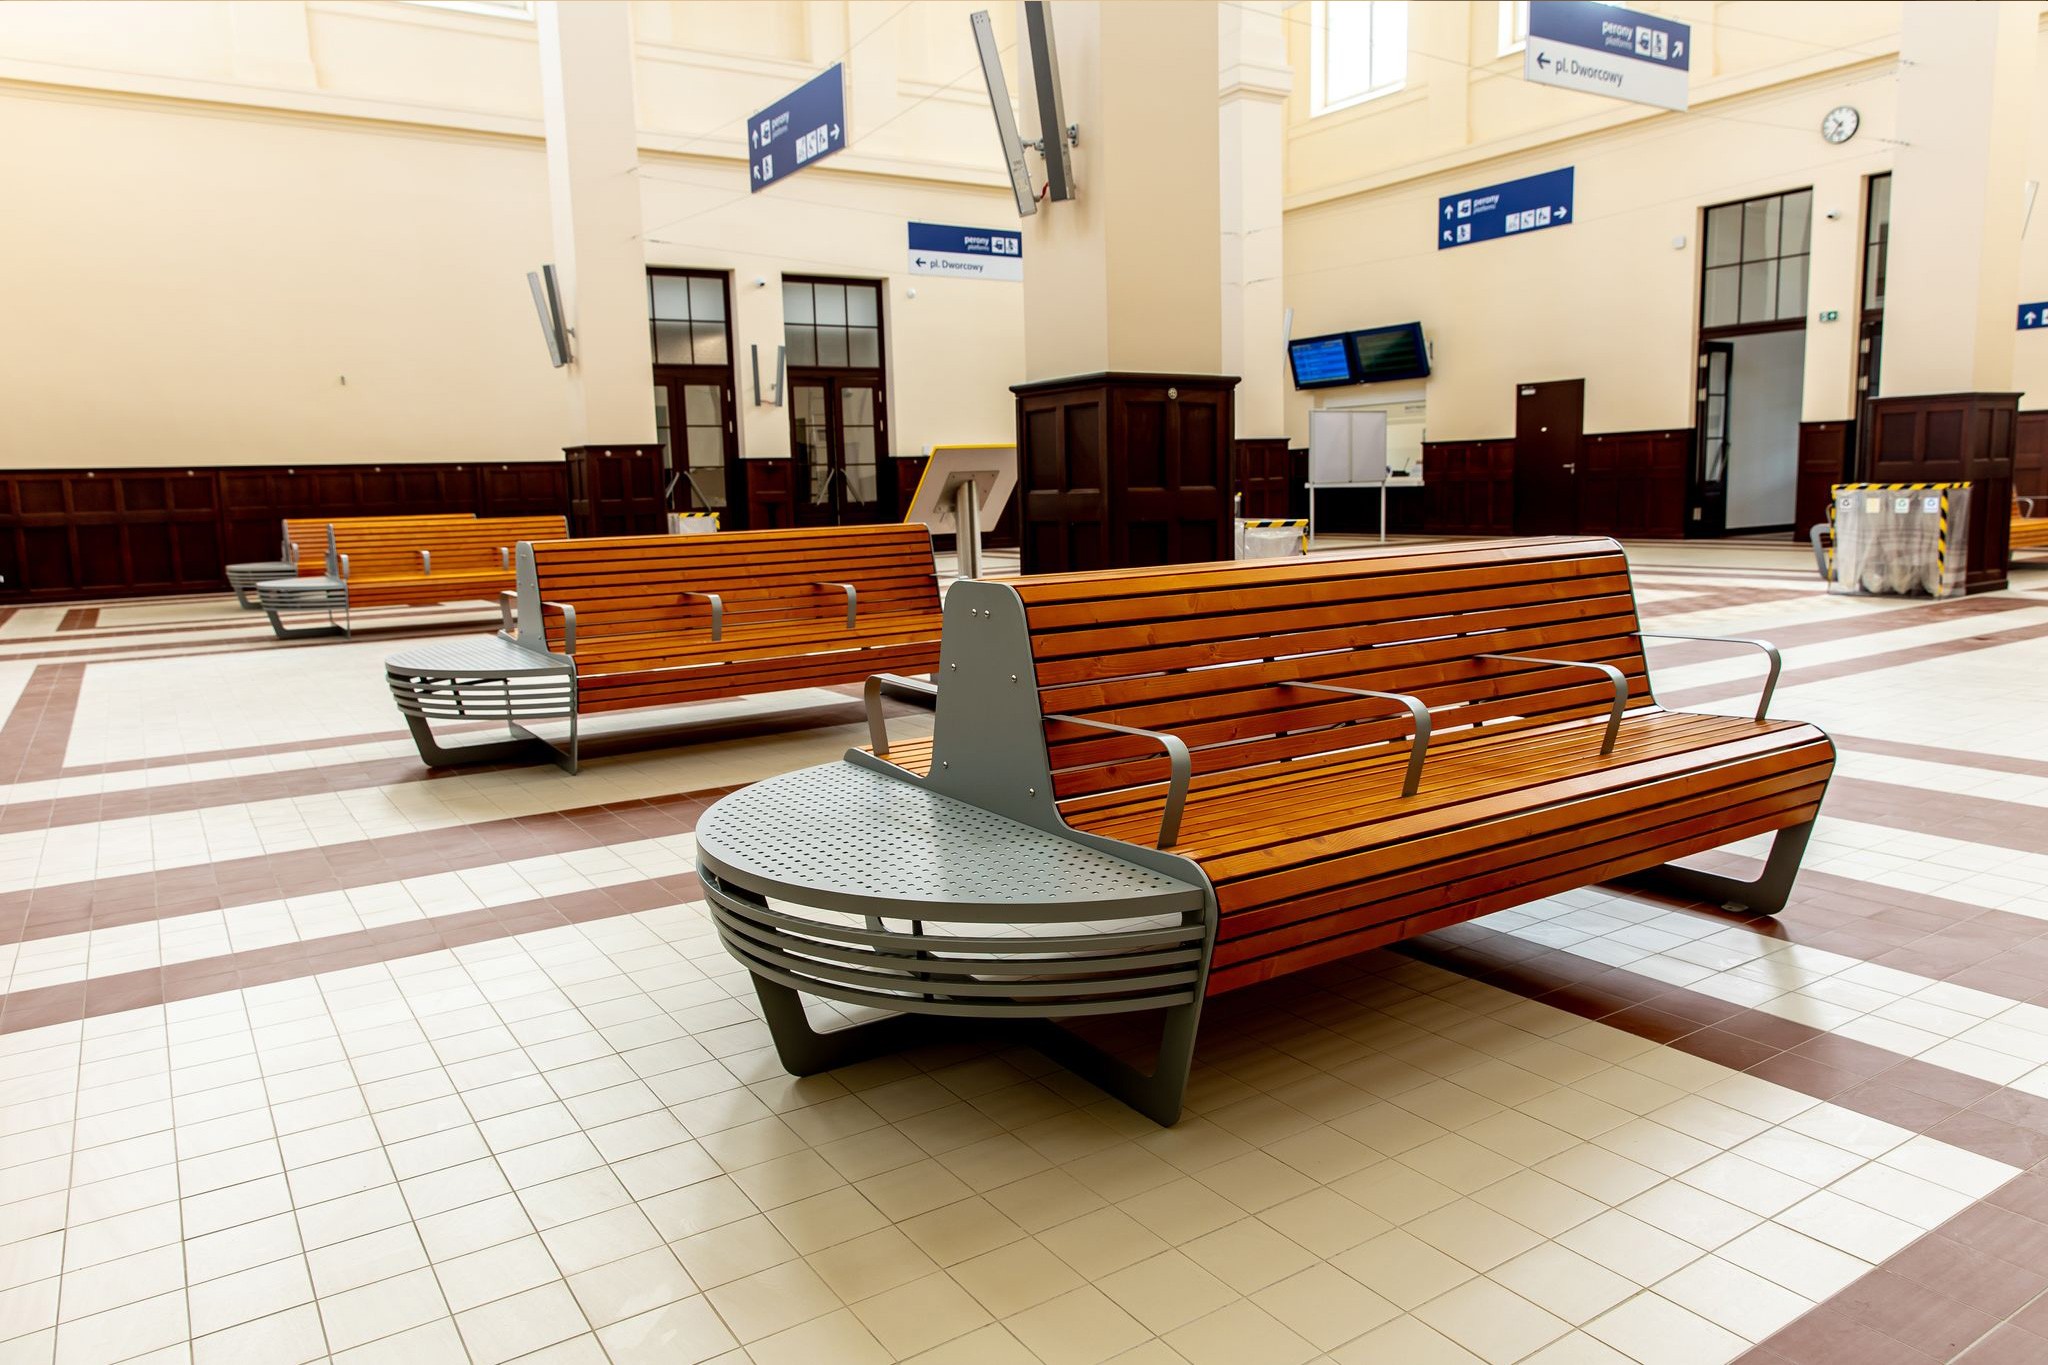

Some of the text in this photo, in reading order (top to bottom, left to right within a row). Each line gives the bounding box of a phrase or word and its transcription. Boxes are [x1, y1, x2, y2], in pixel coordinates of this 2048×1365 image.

[1602, 21, 1633, 40] perony
[1555, 58, 1624, 88] pl. Dworcowy
[964, 236, 989, 246] perony
[930, 259, 984, 272] pl. Dworcowy
